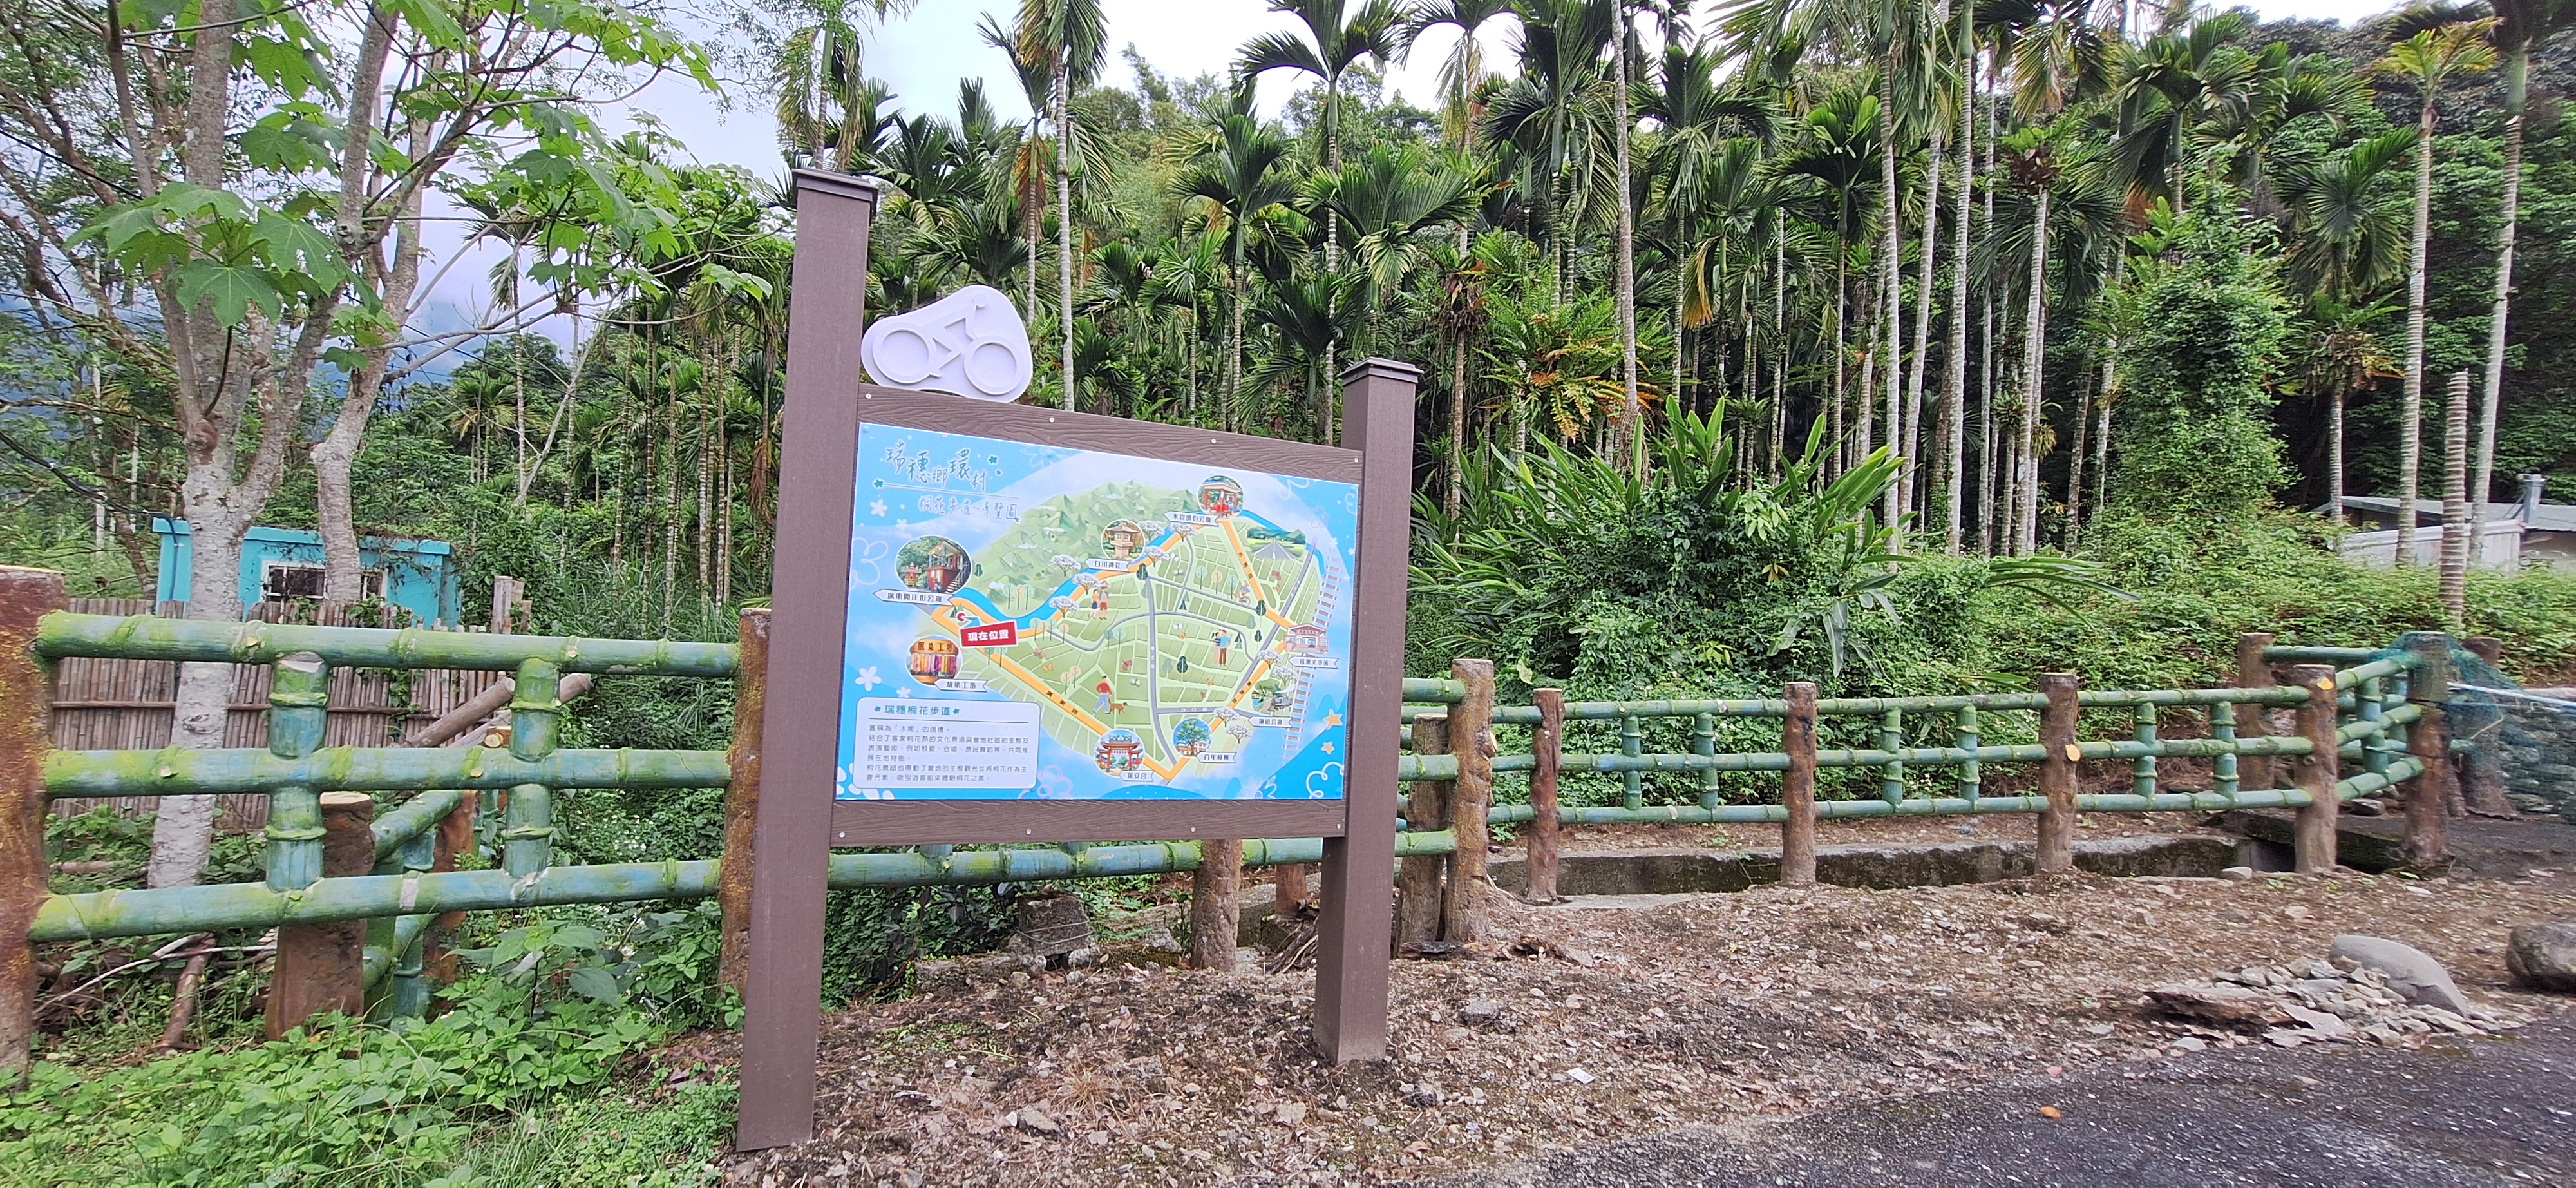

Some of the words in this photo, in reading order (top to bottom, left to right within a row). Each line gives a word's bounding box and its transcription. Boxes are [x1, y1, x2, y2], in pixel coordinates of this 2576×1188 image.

[886, 441, 987, 492] 瑞穗鄉環村
[967, 629, 1009, 642] 現在位置
[884, 705, 950, 716] 瑞穗桐花步道
